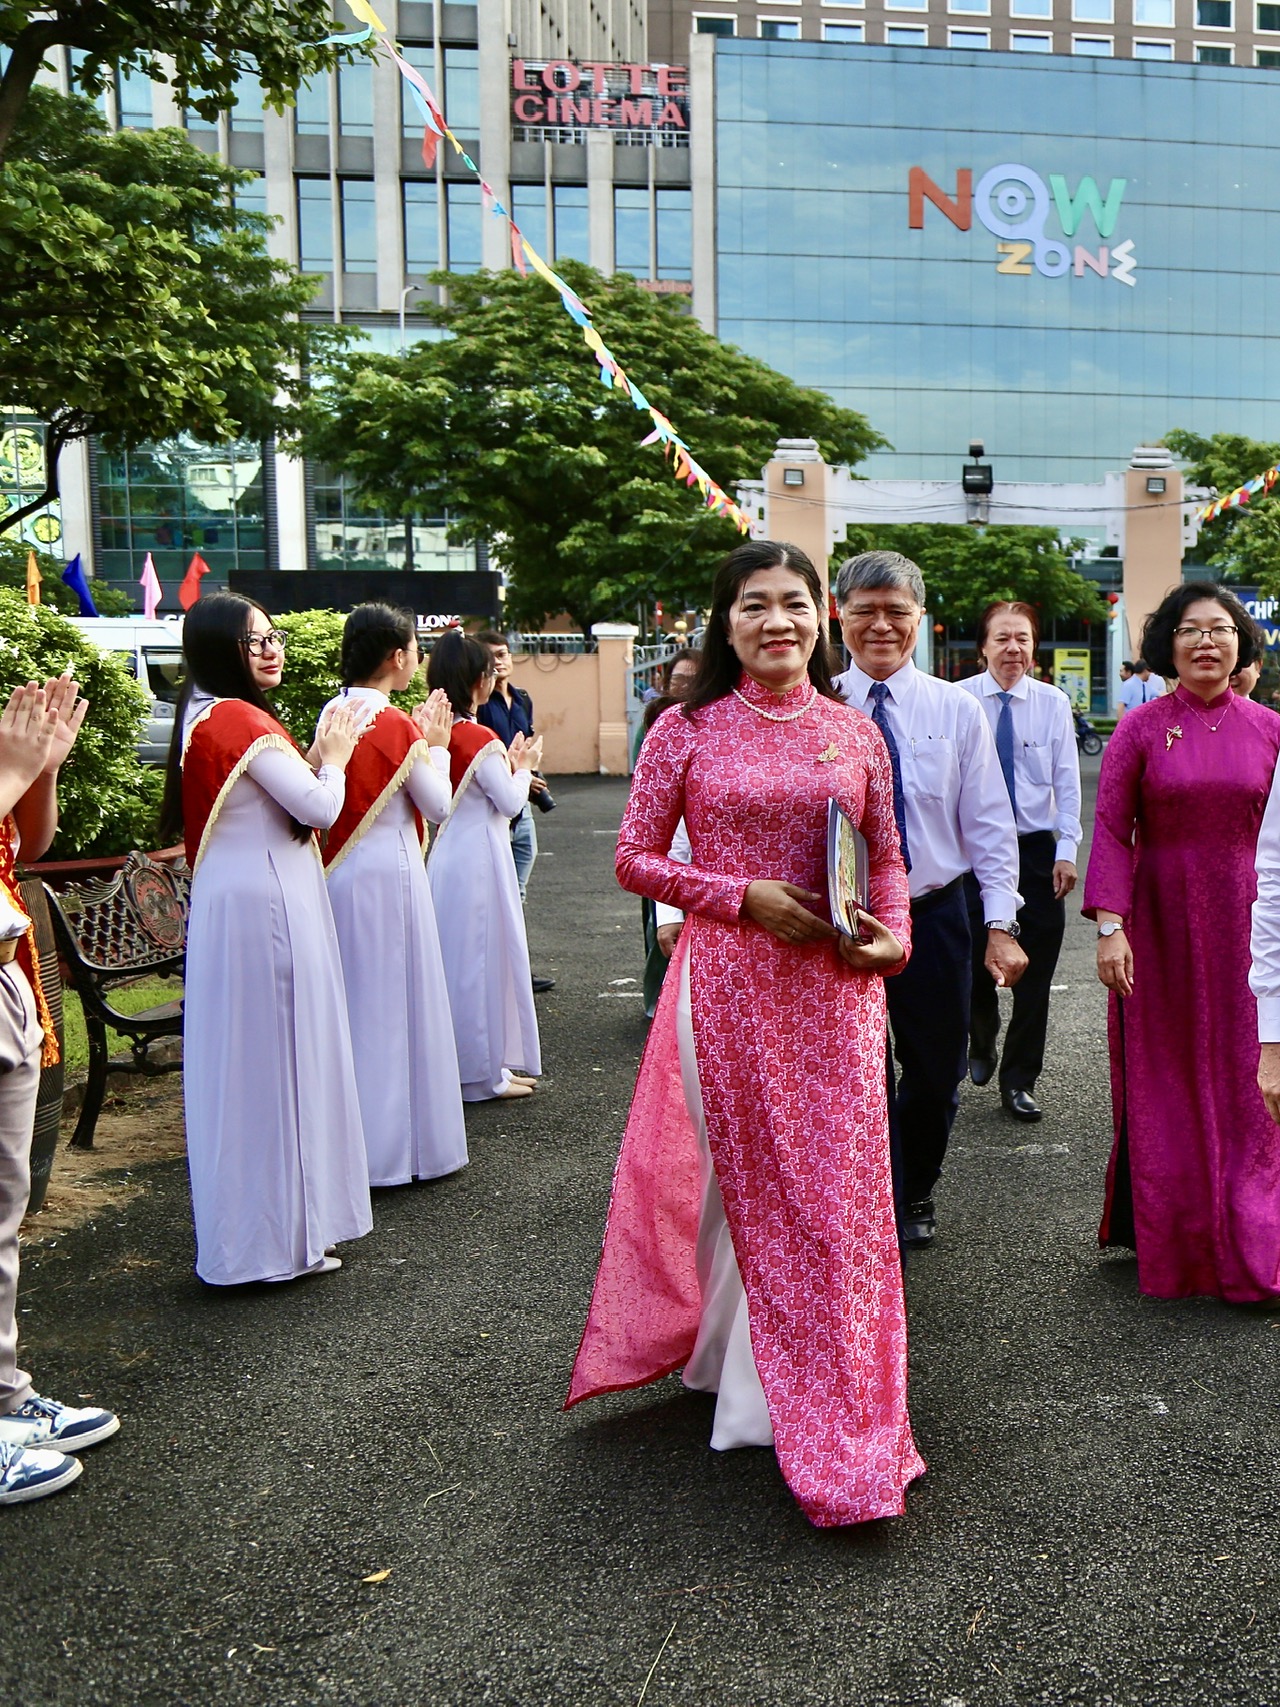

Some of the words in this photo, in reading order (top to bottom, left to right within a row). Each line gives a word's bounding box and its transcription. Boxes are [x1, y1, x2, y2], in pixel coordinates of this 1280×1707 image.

[513, 58, 688, 97] LOTTE
[513, 94, 687, 128] CINEMA
[908, 162, 1129, 240] NOW
